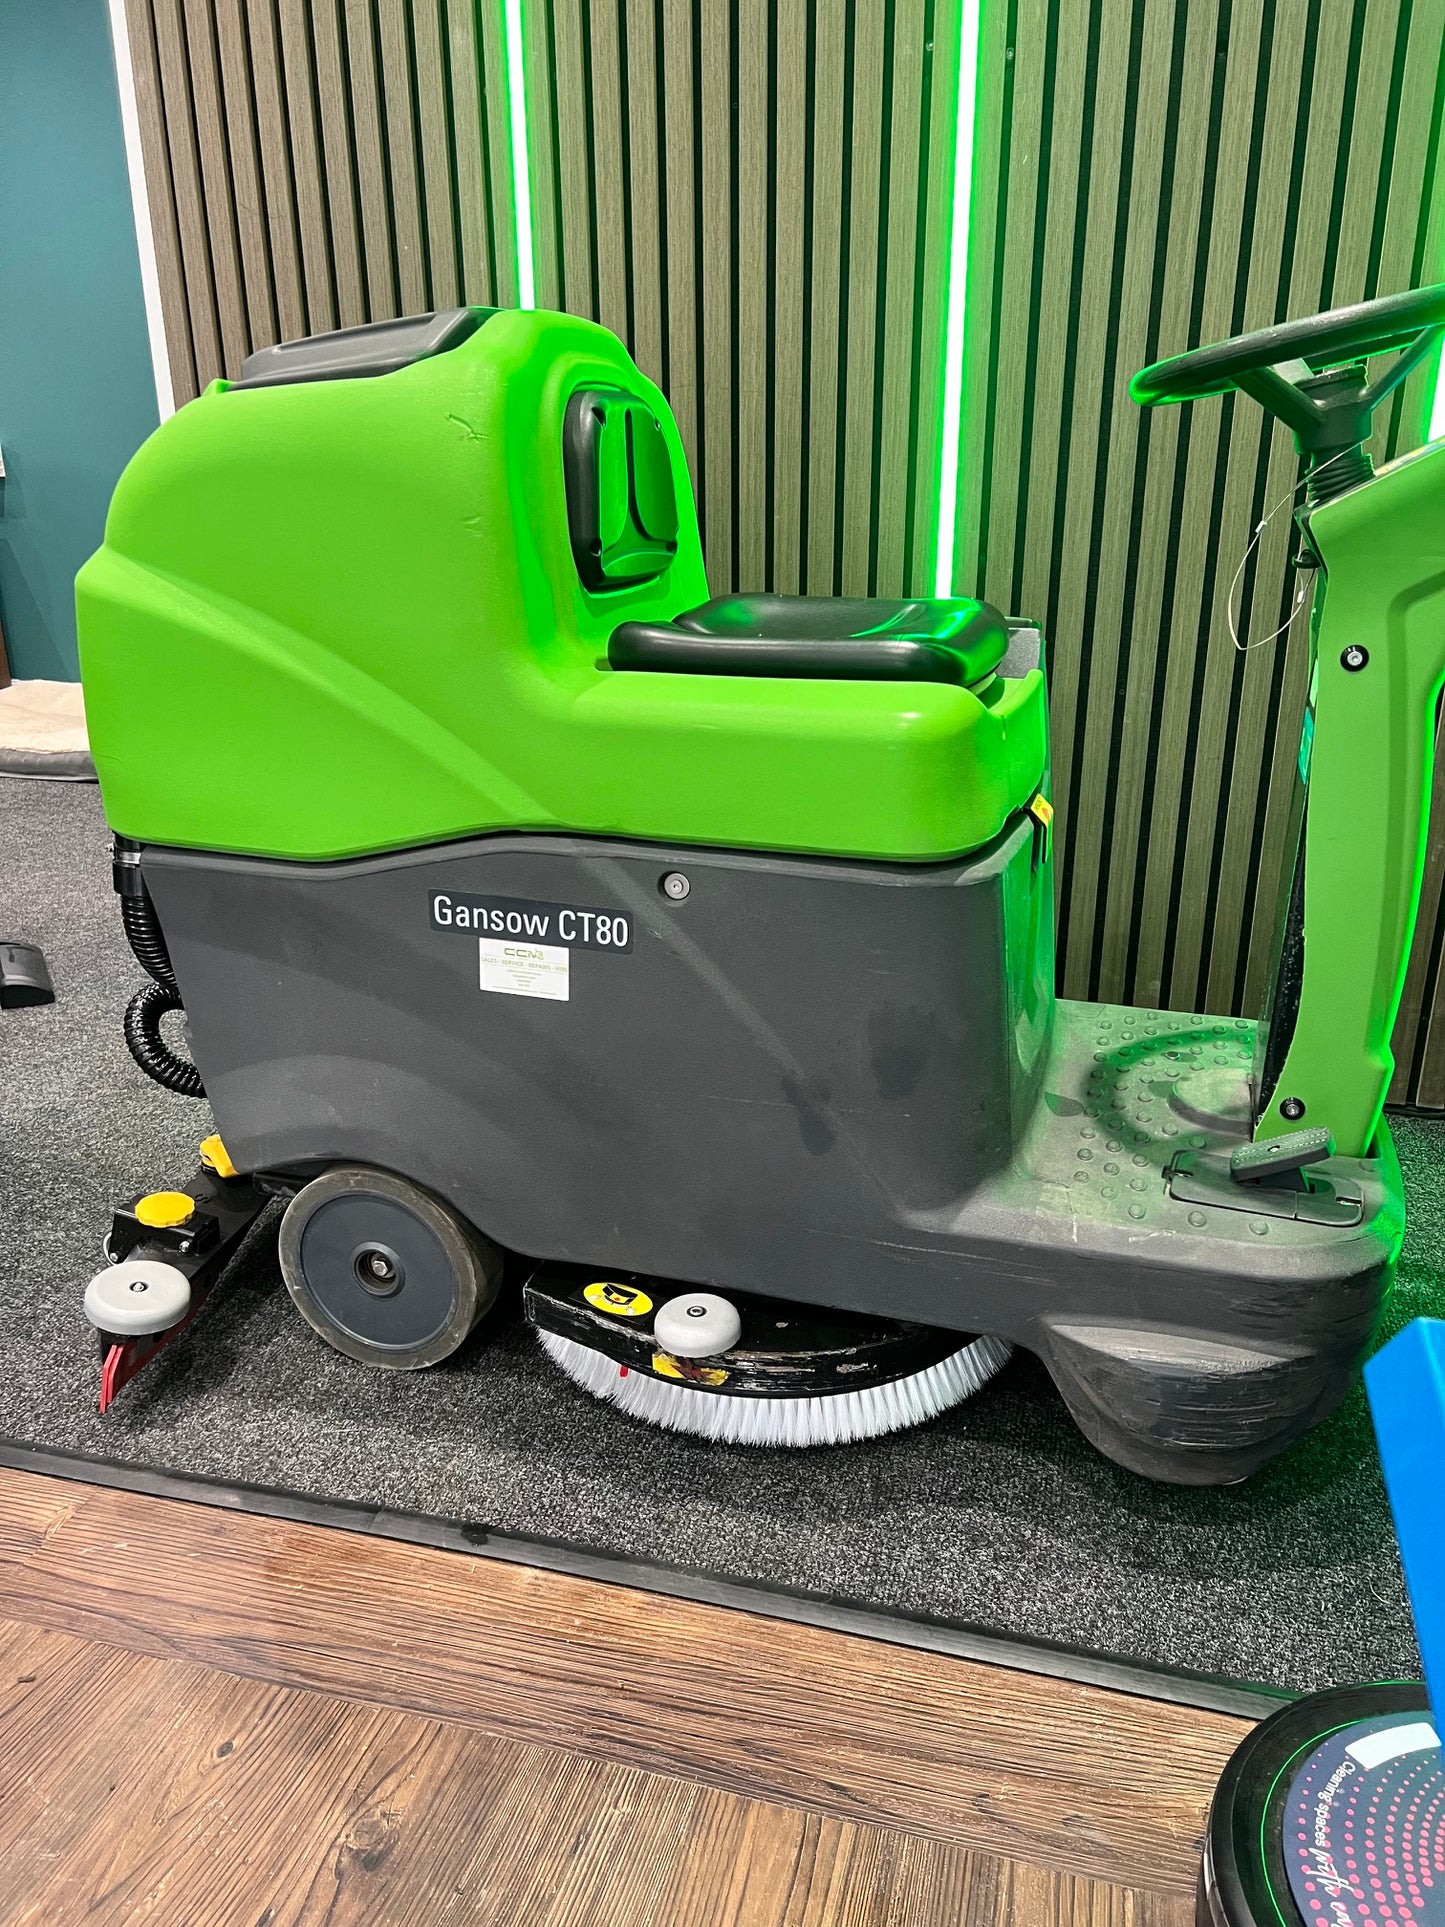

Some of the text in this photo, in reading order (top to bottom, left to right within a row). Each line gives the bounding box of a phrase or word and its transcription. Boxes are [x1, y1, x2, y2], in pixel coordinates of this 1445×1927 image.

[433, 895, 629, 947] Gansow CT80
[502, 959, 524, 967] SERVICE
[528, 963, 551, 971] REPAIRS
[1317, 1761, 1356, 1803] Cleaning
[1313, 1803, 1329, 1847] spaces
[1306, 1847, 1354, 1898] with
